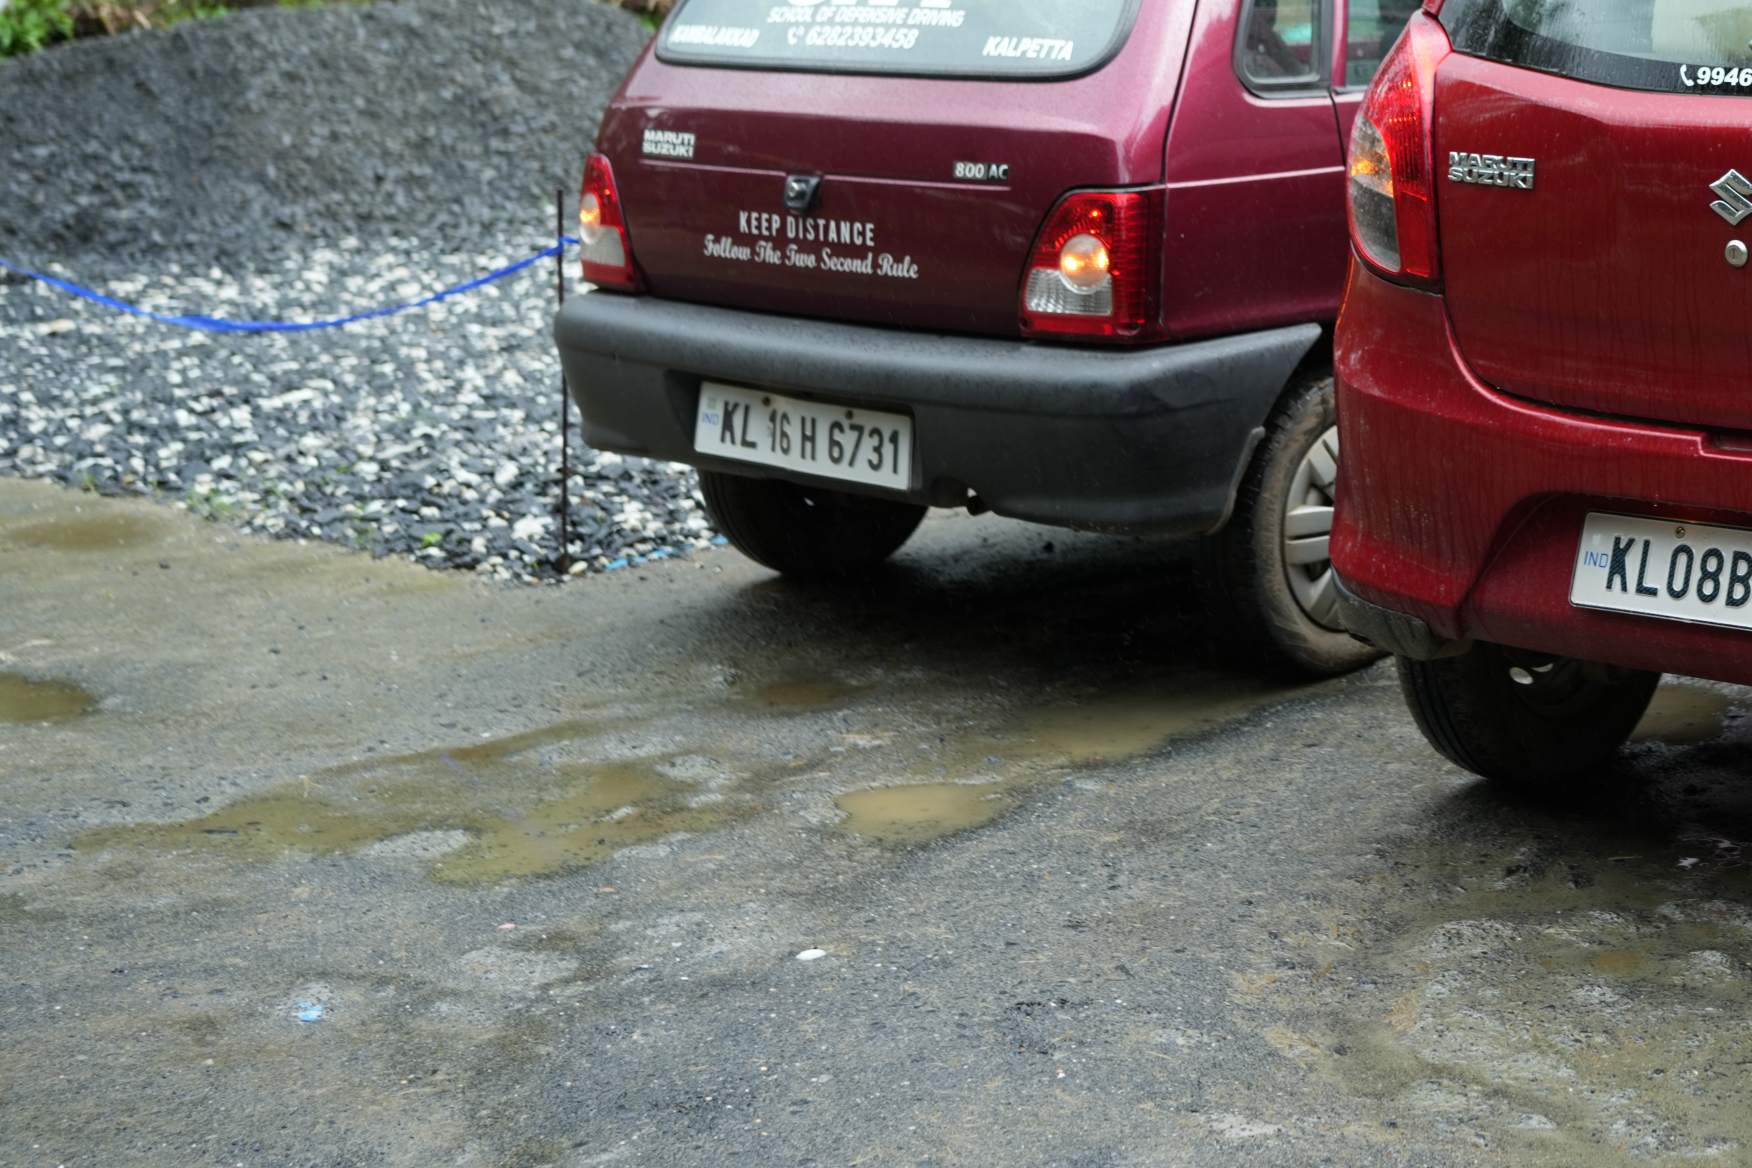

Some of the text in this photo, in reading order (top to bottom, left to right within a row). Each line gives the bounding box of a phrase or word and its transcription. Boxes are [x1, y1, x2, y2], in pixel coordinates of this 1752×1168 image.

[767, 6, 966, 27] SCHOOL OF DEFENSIVE DRIVING
[982, 36, 1074, 60] KALPETTA
[1696, 66, 1752, 87] 9946
[643, 130, 695, 145] MARUTI
[642, 142, 694, 157] SUZUKI
[954, 162, 1009, 180] 800 AC
[1447, 167, 1534, 189] SUZUKI
[739, 210, 875, 247] KEEP DISTANCE
[704, 234, 919, 279] Follow The Two Second Rule
[720, 399, 899, 475] KL 16 H 6731
[1583, 550, 1608, 569] IND
